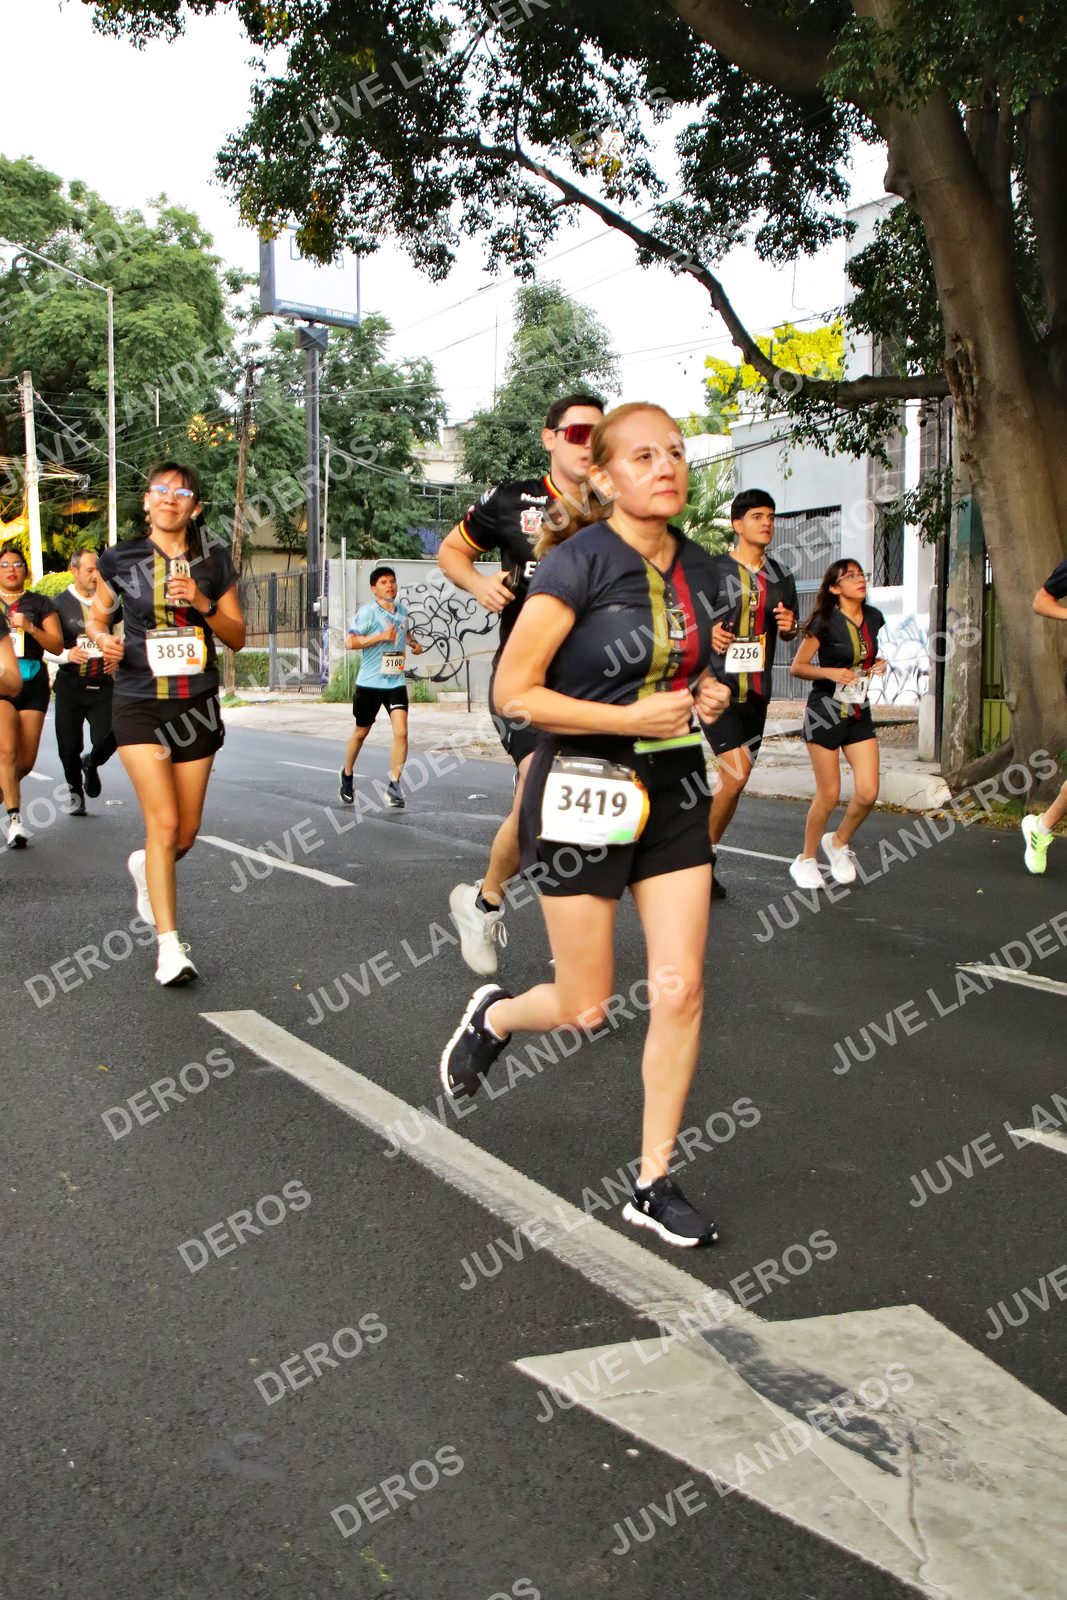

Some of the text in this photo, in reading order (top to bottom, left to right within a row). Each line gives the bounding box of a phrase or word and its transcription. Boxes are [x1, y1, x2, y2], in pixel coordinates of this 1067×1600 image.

[156, 643, 195, 659] 3858
[732, 647, 759, 660] 2256
[557, 784, 628, 817] 3419
